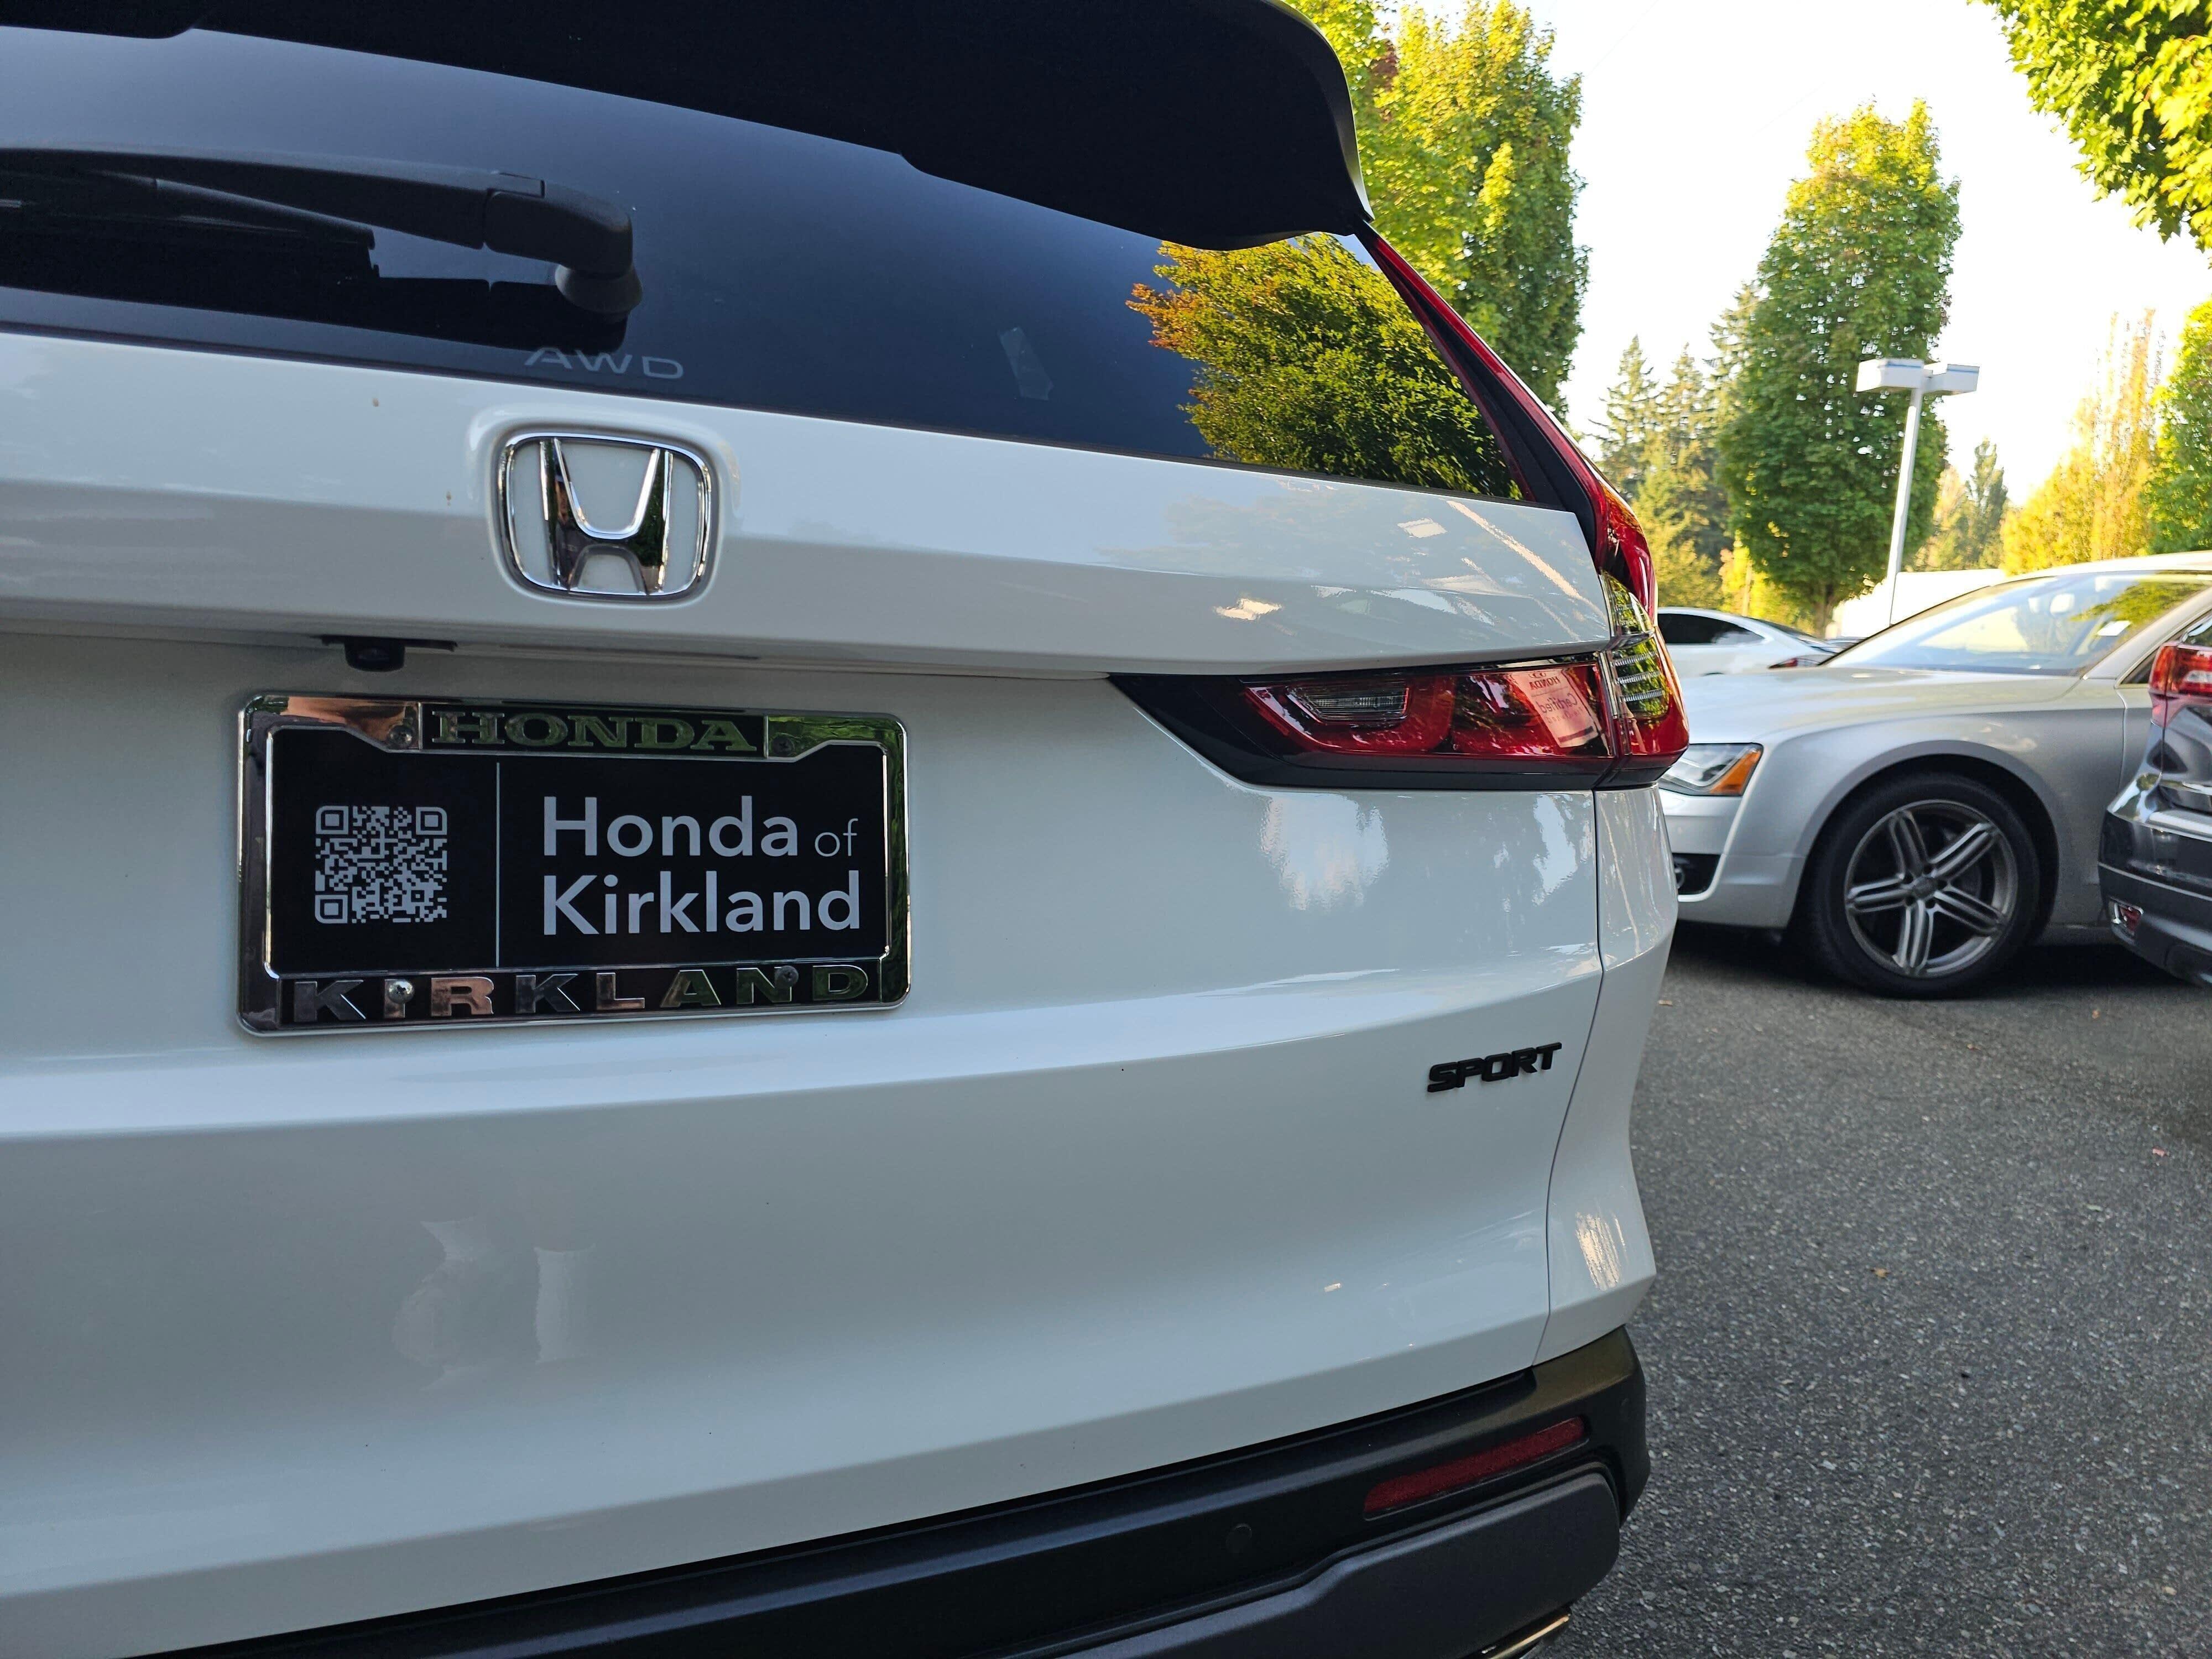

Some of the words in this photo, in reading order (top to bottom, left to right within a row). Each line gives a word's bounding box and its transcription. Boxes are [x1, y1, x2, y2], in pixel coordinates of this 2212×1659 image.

[524, 347, 684, 379] AWD
[431, 710, 757, 752] HONDA
[544, 795, 798, 857] Honda
[814, 818, 857, 857] of
[543, 870, 860, 936] Kirkland
[293, 964, 869, 1022] KIRKLAND
[1427, 1042, 1562, 1093] SPORT
